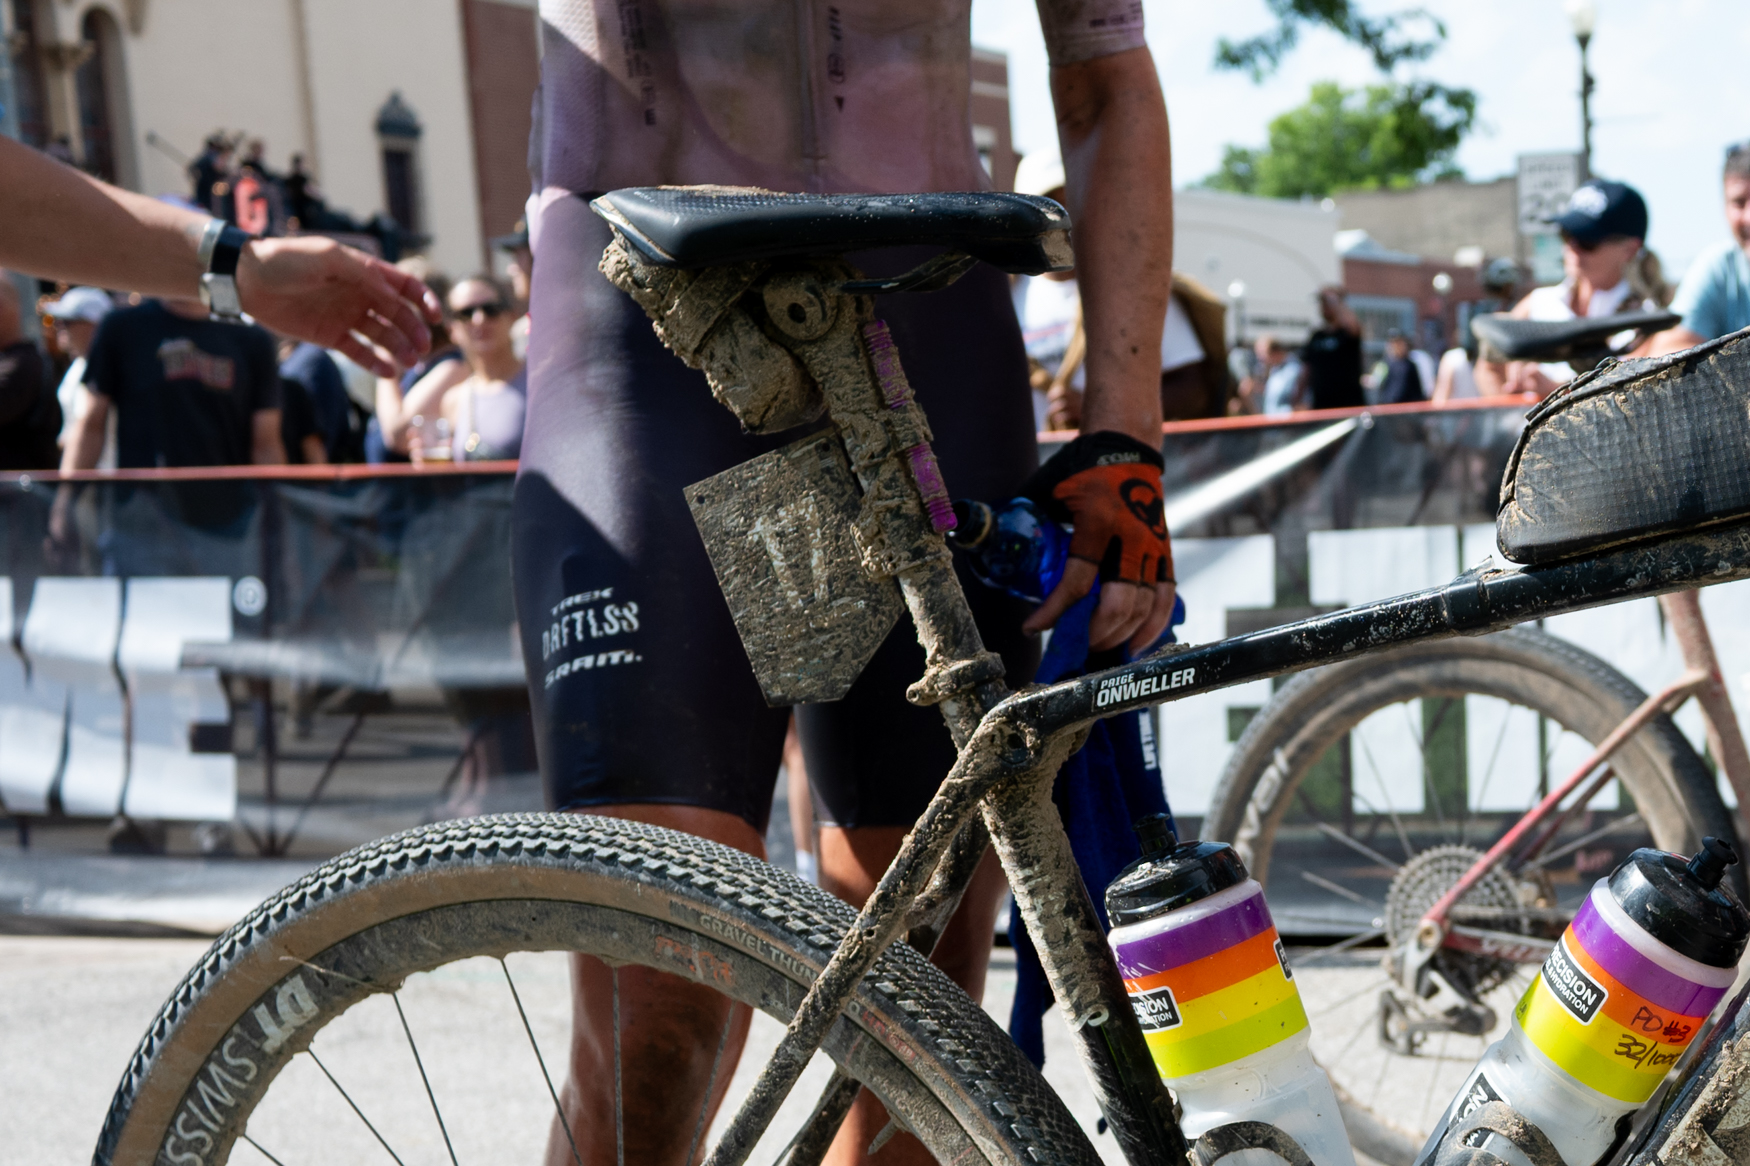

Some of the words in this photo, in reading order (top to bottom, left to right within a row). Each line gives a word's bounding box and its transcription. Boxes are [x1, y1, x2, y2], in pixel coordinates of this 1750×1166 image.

[1096, 667, 1196, 707] ONWELLER
[1101, 672, 1135, 690] PAIGE
[700, 914, 768, 956] GRAVEL
[1552, 970, 1590, 1015] HYDRATION
[254, 973, 320, 1055] DT
